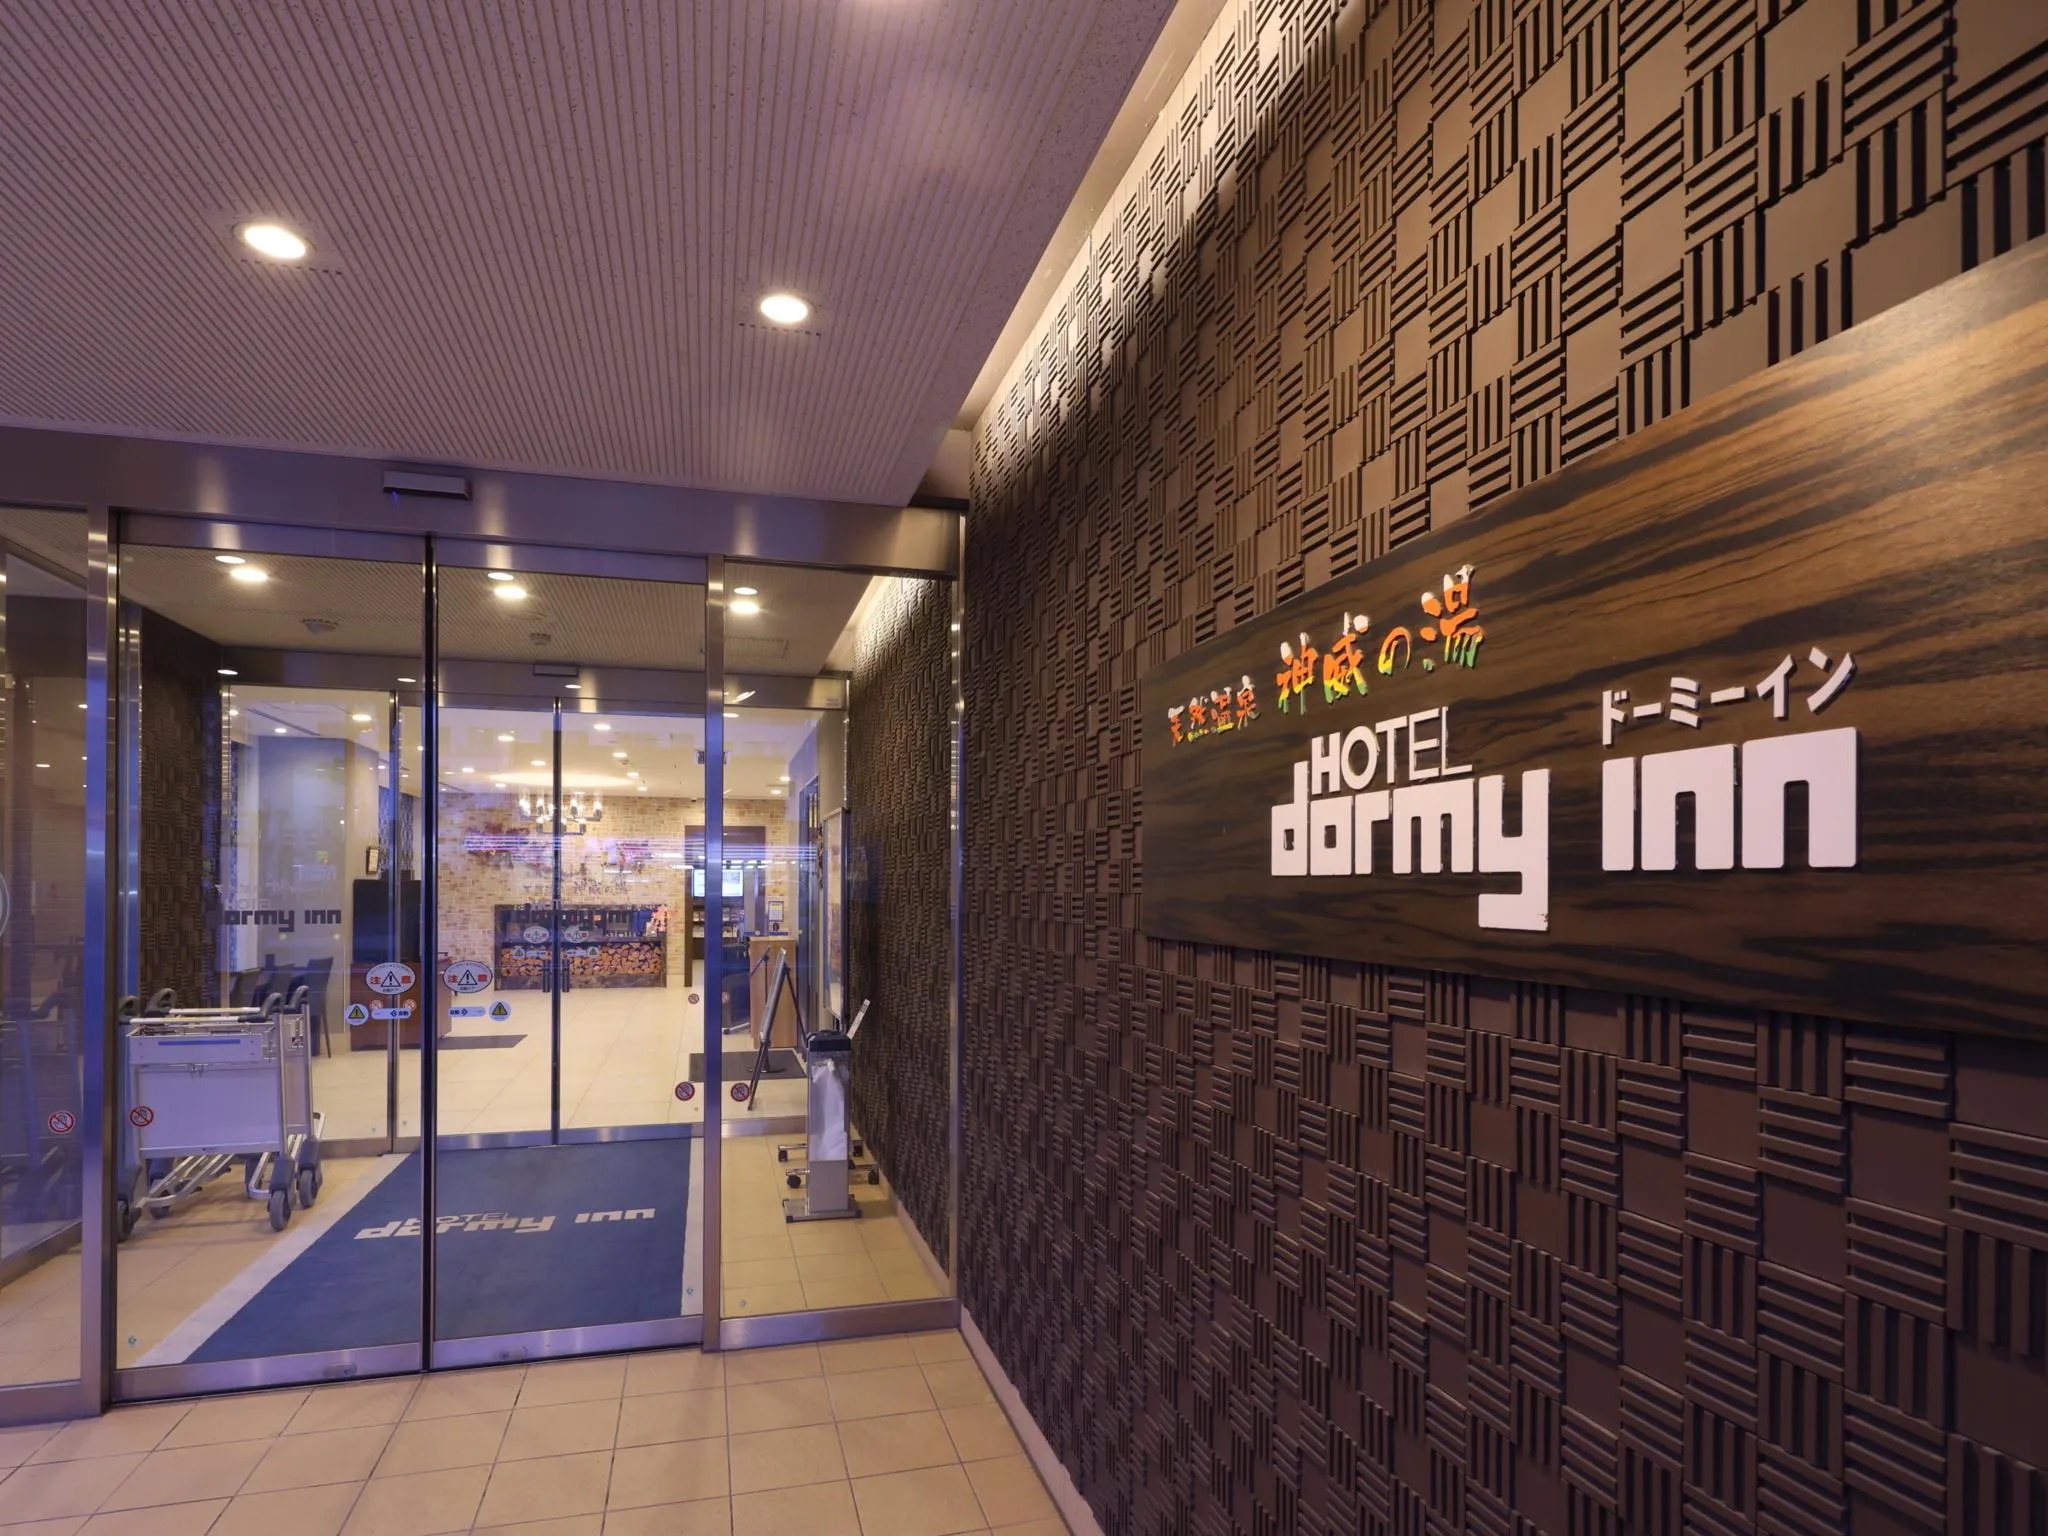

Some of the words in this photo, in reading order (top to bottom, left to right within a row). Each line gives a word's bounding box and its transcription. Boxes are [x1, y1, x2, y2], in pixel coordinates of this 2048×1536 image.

[1603, 646, 1856, 746] ドーミーイン
[1311, 706, 1473, 795] HOTEL
[1271, 768, 1550, 931] dormy
[1602, 727, 1857, 871] inn
[222, 910, 295, 932] ormy
[304, 910, 341, 924] inn
[574, 1208, 656, 1224] inn
